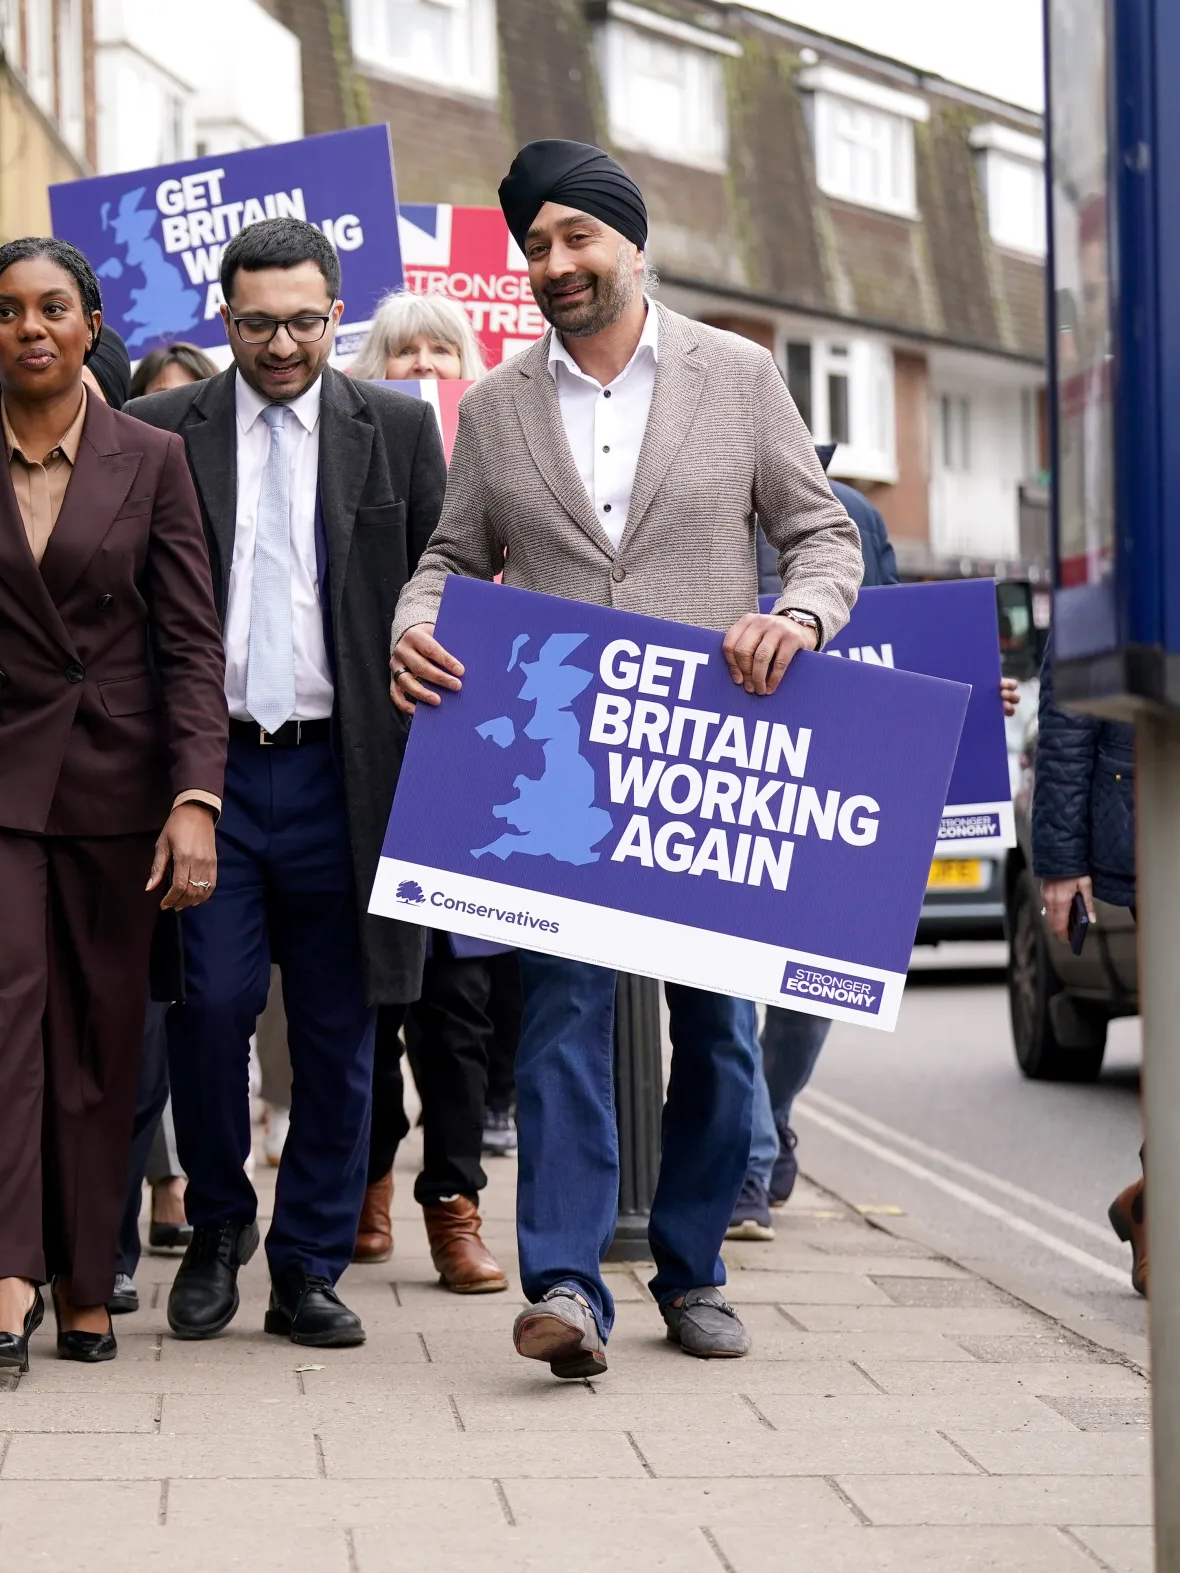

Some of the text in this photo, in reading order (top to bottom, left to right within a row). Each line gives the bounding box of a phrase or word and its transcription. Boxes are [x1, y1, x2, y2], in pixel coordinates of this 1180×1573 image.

[156, 168, 225, 216] GET
[404, 270, 536, 301] TRONGE
[599, 638, 709, 701] GET
[589, 692, 812, 778] BRITAIN
[608, 752, 880, 847] WORKING
[941, 815, 991, 827] TRONGER
[938, 823, 997, 838] CONOMY
[610, 814, 795, 891] AGAIN
[430, 891, 560, 934] Conservatives
[786, 977, 876, 1008] ECONOMY
[795, 968, 871, 994] STRONGER
